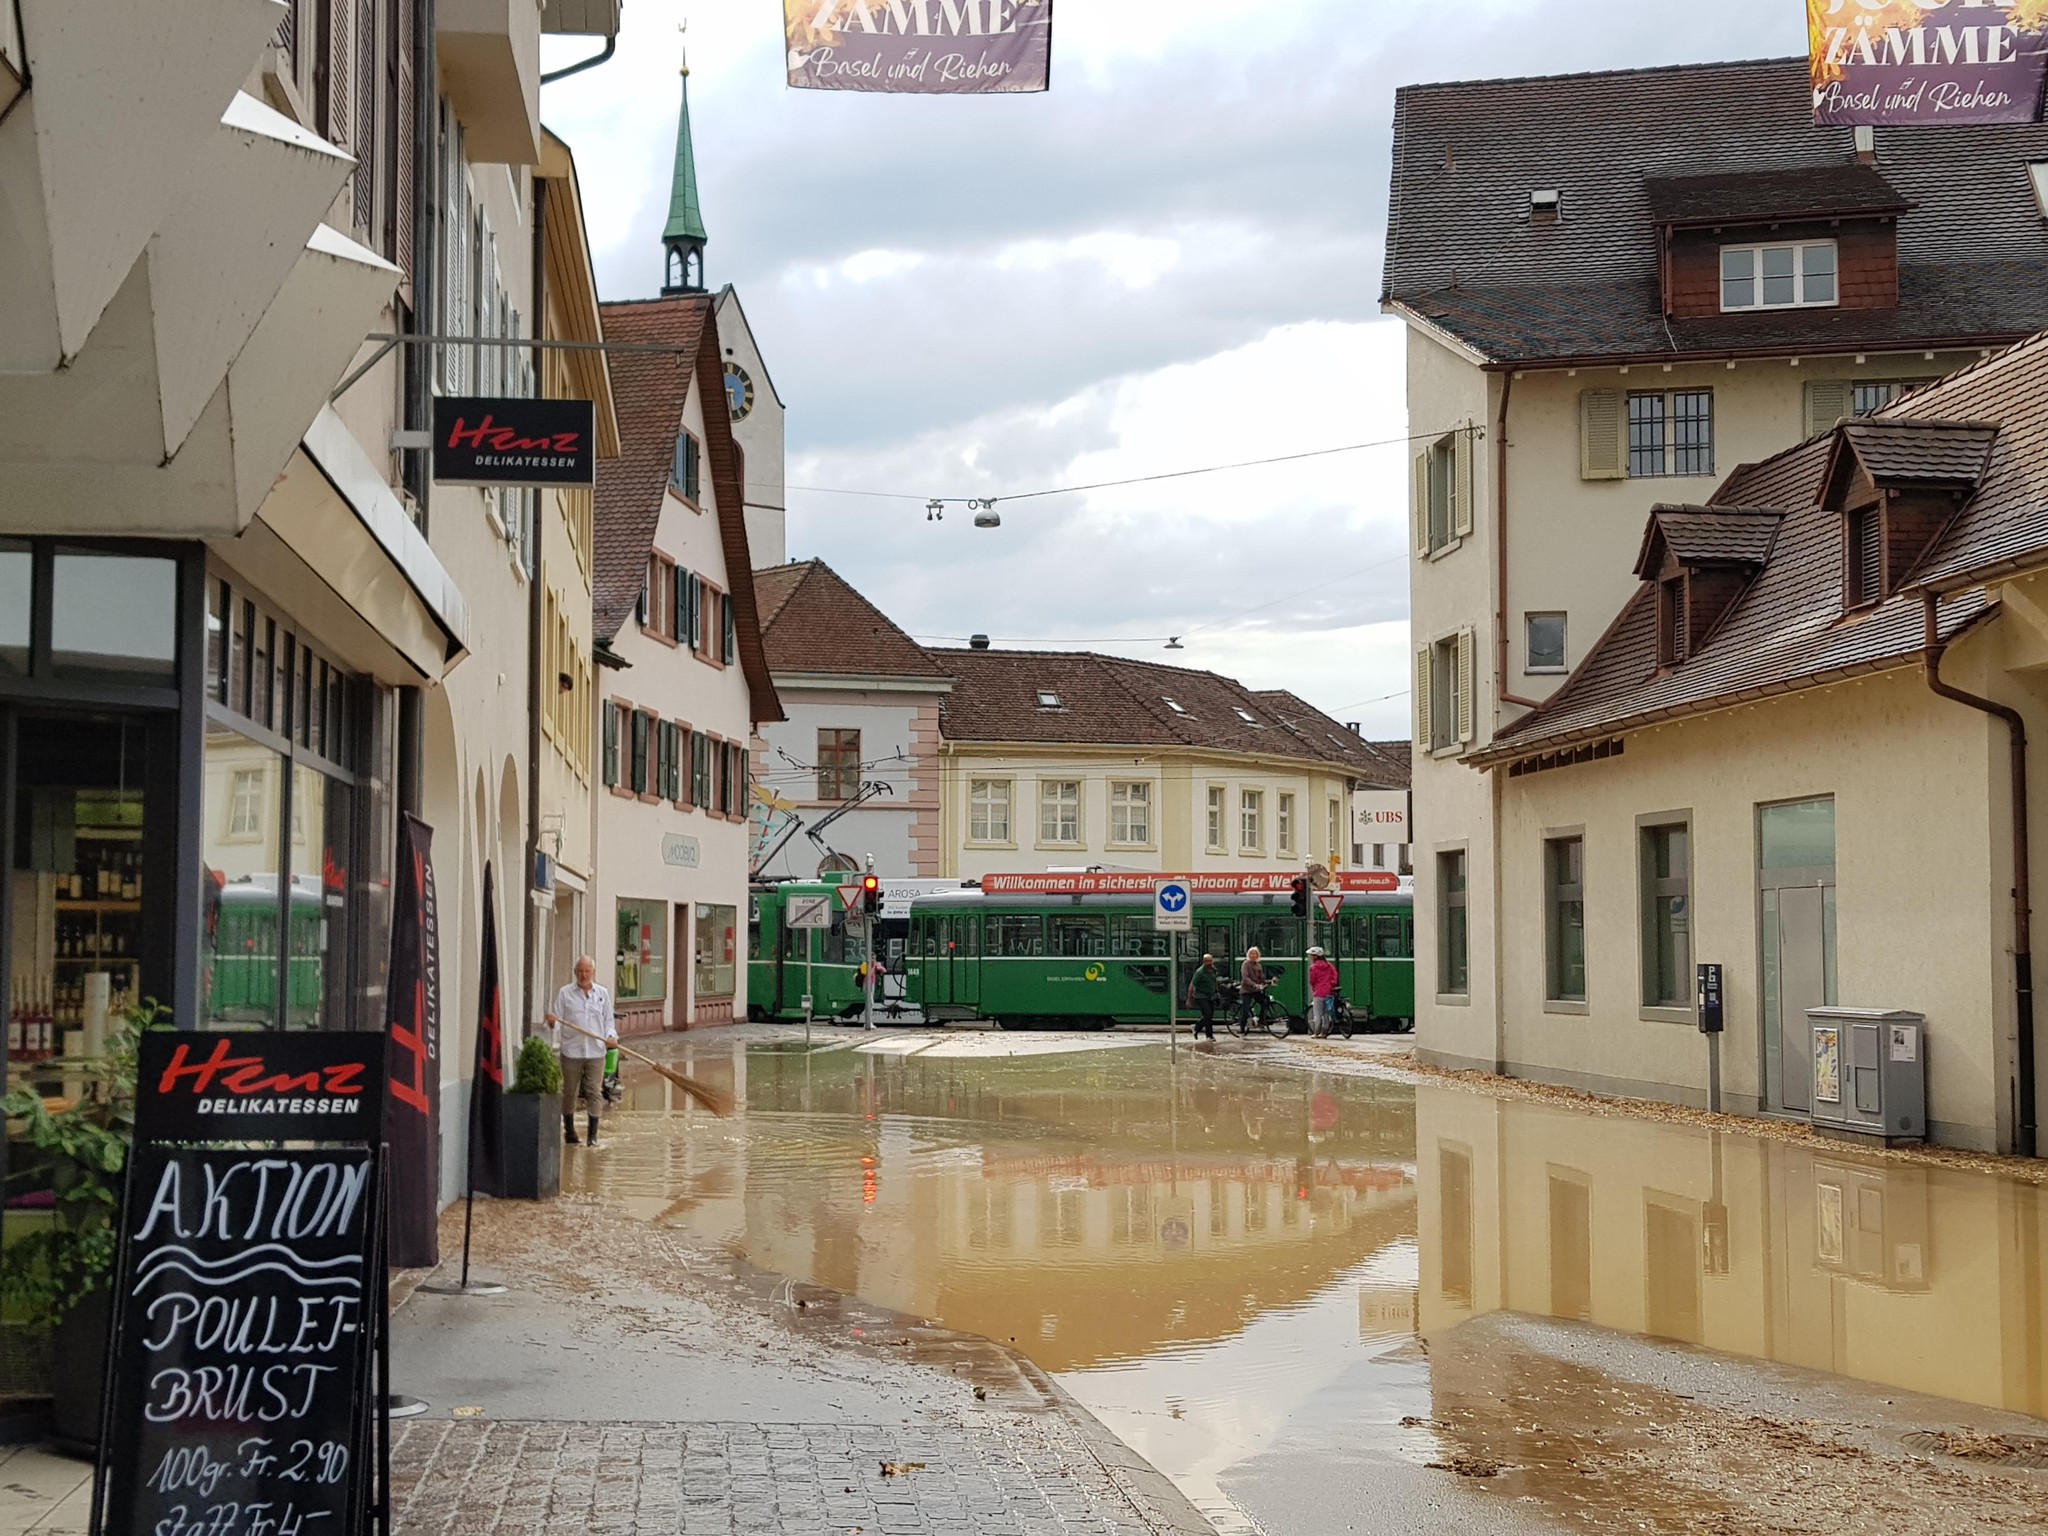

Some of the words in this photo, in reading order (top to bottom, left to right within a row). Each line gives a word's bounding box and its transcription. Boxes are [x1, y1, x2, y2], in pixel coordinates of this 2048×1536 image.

[1824, 15, 2020, 66] ZÄMME
[808, 46, 882, 79] Basel
[933, 50, 1013, 83] Riehen
[1824, 80, 1881, 113] Basel
[1928, 80, 2012, 113] Riehen
[447, 414, 580, 453] Henz
[475, 455, 576, 468] DELIKATESSEN
[1375, 811, 1403, 824] UBS
[888, 889, 921, 899] AROSA
[993, 875, 1077, 890] Willkommen
[1078, 875, 1095, 890] im
[1241, 873, 1265, 889] der
[425, 863, 437, 1060] DELIKATESSEN
[158, 1038, 366, 1094] Henz
[197, 1098, 360, 1115] DELIKATESSEN
[133, 1159, 371, 1241] AKTION
[144, 1363, 338, 1422] BRUST
[145, 1445, 232, 1498] 100gr.
[237, 1437, 278, 1478] Fr.
[278, 1439, 349, 1485] 2.90
